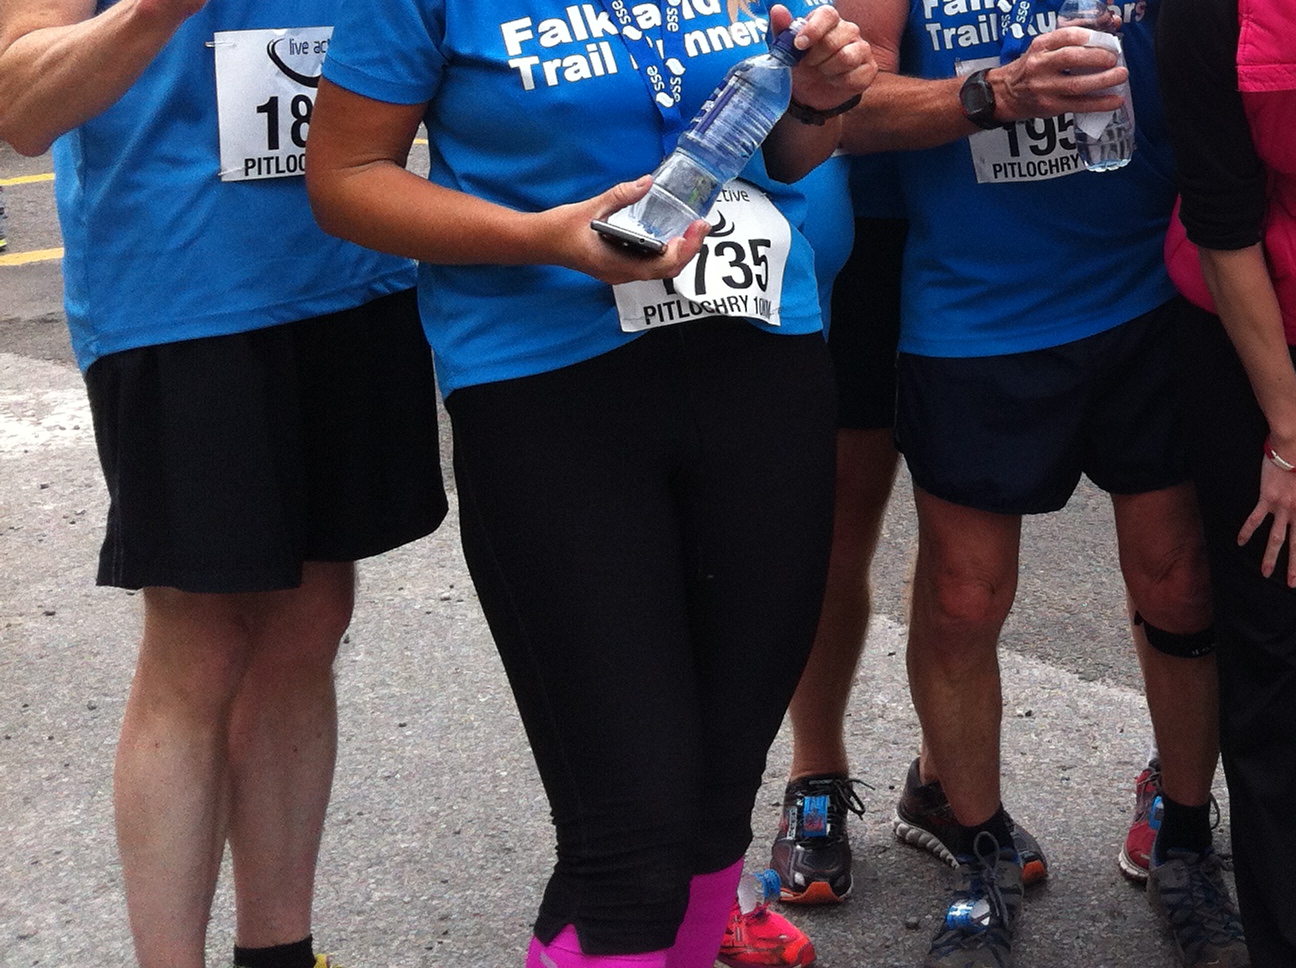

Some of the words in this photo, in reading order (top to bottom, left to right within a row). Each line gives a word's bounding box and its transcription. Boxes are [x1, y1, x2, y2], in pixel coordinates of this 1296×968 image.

[611, 0, 632, 24] sse
[666, 7, 679, 32] sse
[1016, 0, 1030, 23] sse
[289, 38, 309, 55] live
[508, 41, 618, 91] Trail
[646, 65, 665, 92] sse
[992, 153, 1081, 180] PITLOCHRY
